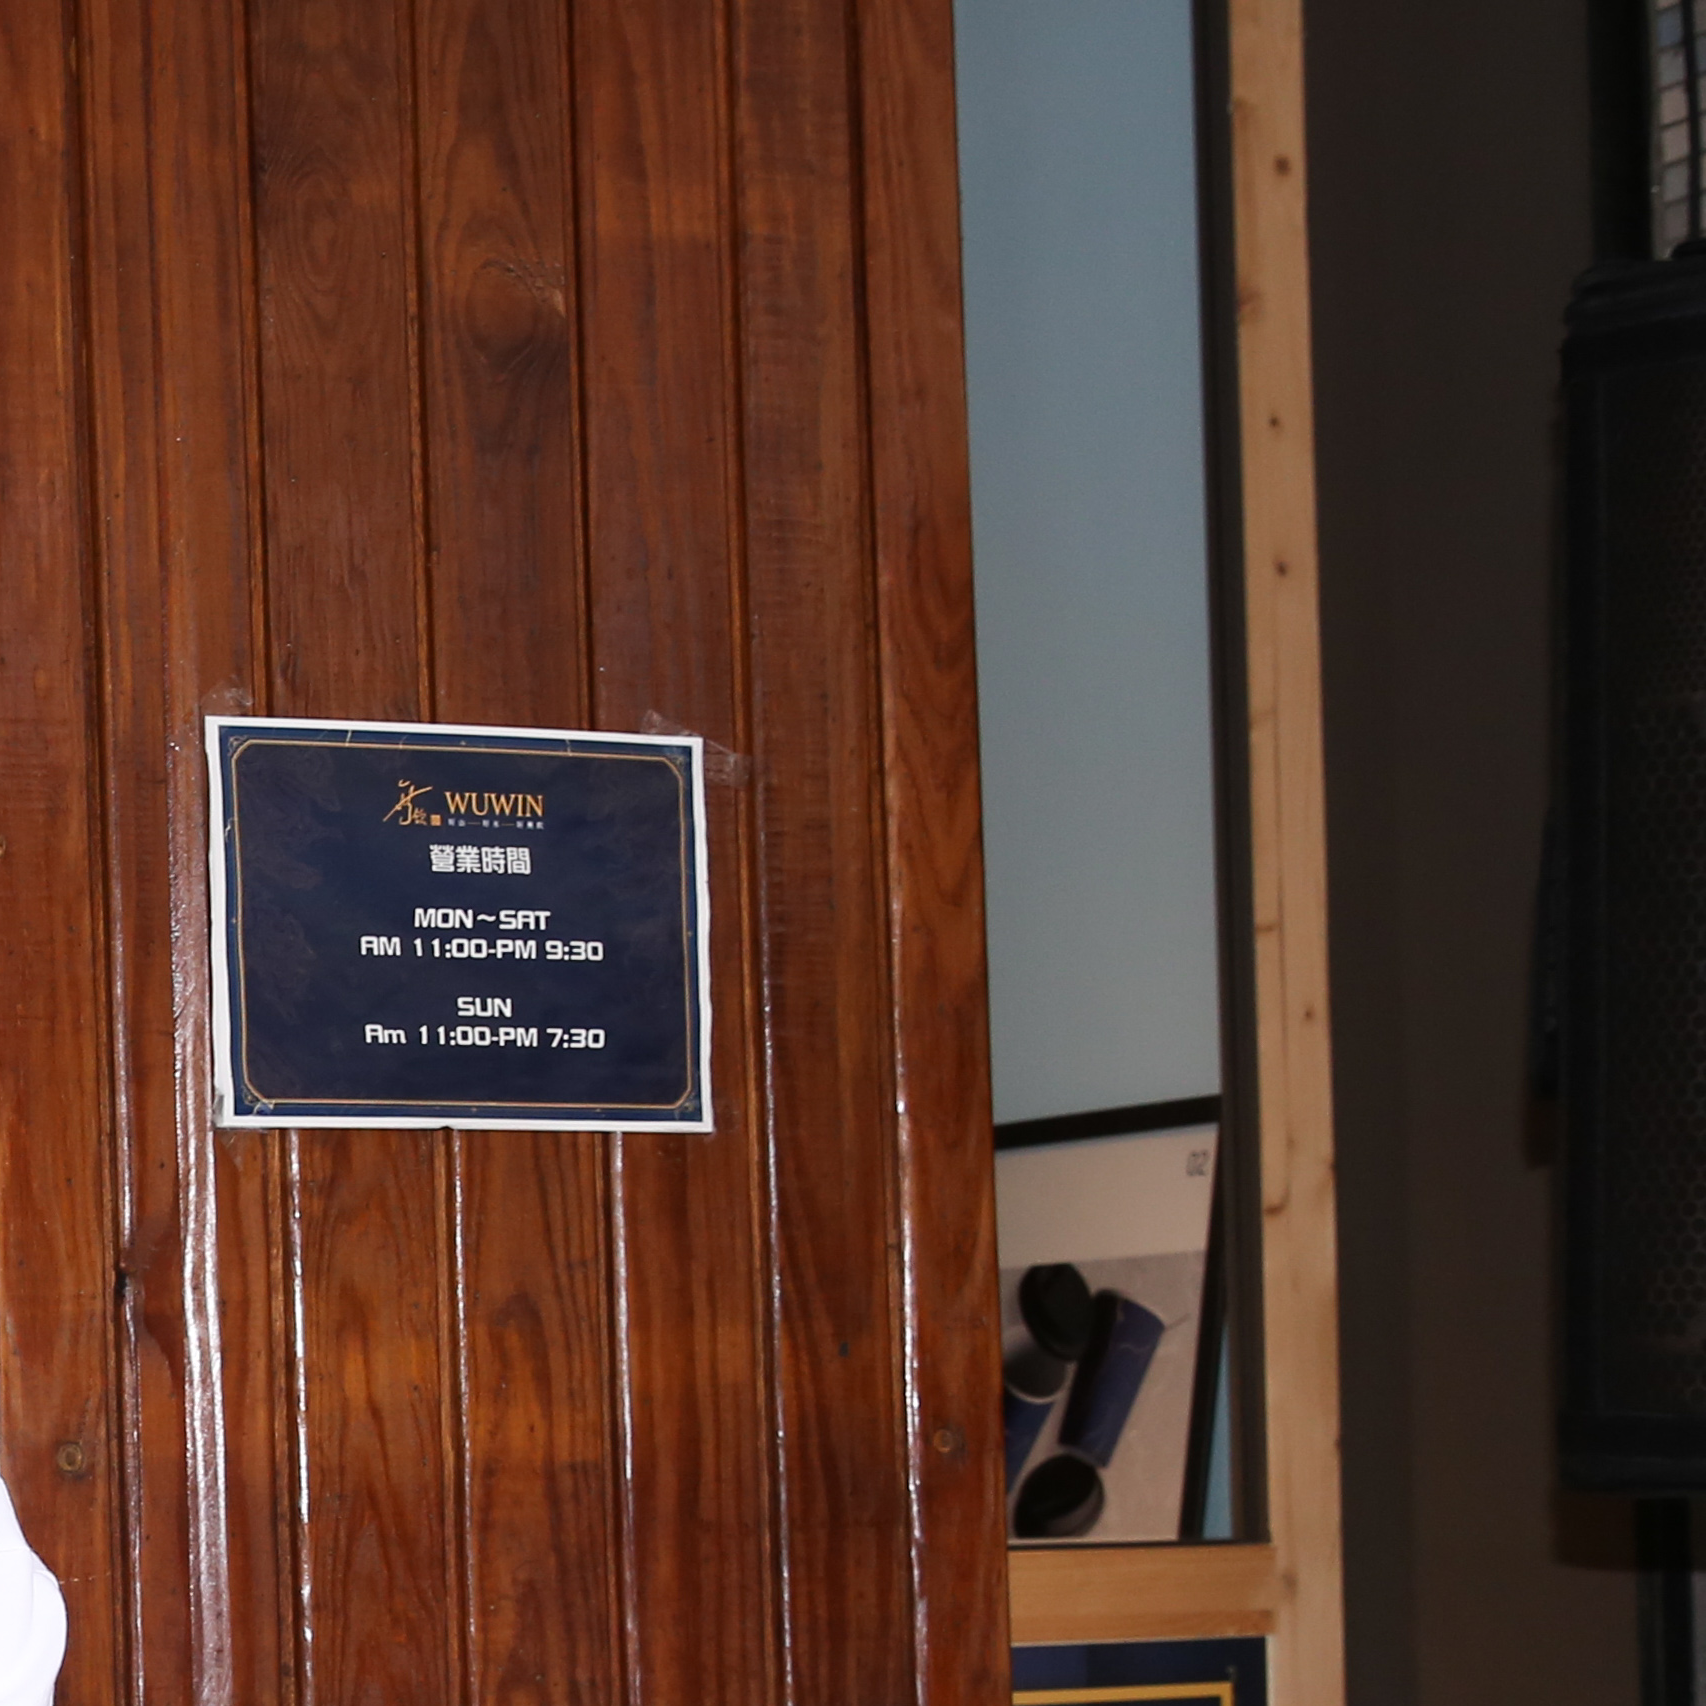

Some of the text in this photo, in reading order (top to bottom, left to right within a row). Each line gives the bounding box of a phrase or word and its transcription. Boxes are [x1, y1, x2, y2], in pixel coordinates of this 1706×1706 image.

[444, 791, 544, 817] WUWIN
[429, 844, 532, 875] 營業時間
[360, 935, 401, 957] AM
[545, 940, 604, 961] 9:30
[457, 997, 512, 1018] SUN
[546, 1027, 605, 1049] 7:30
